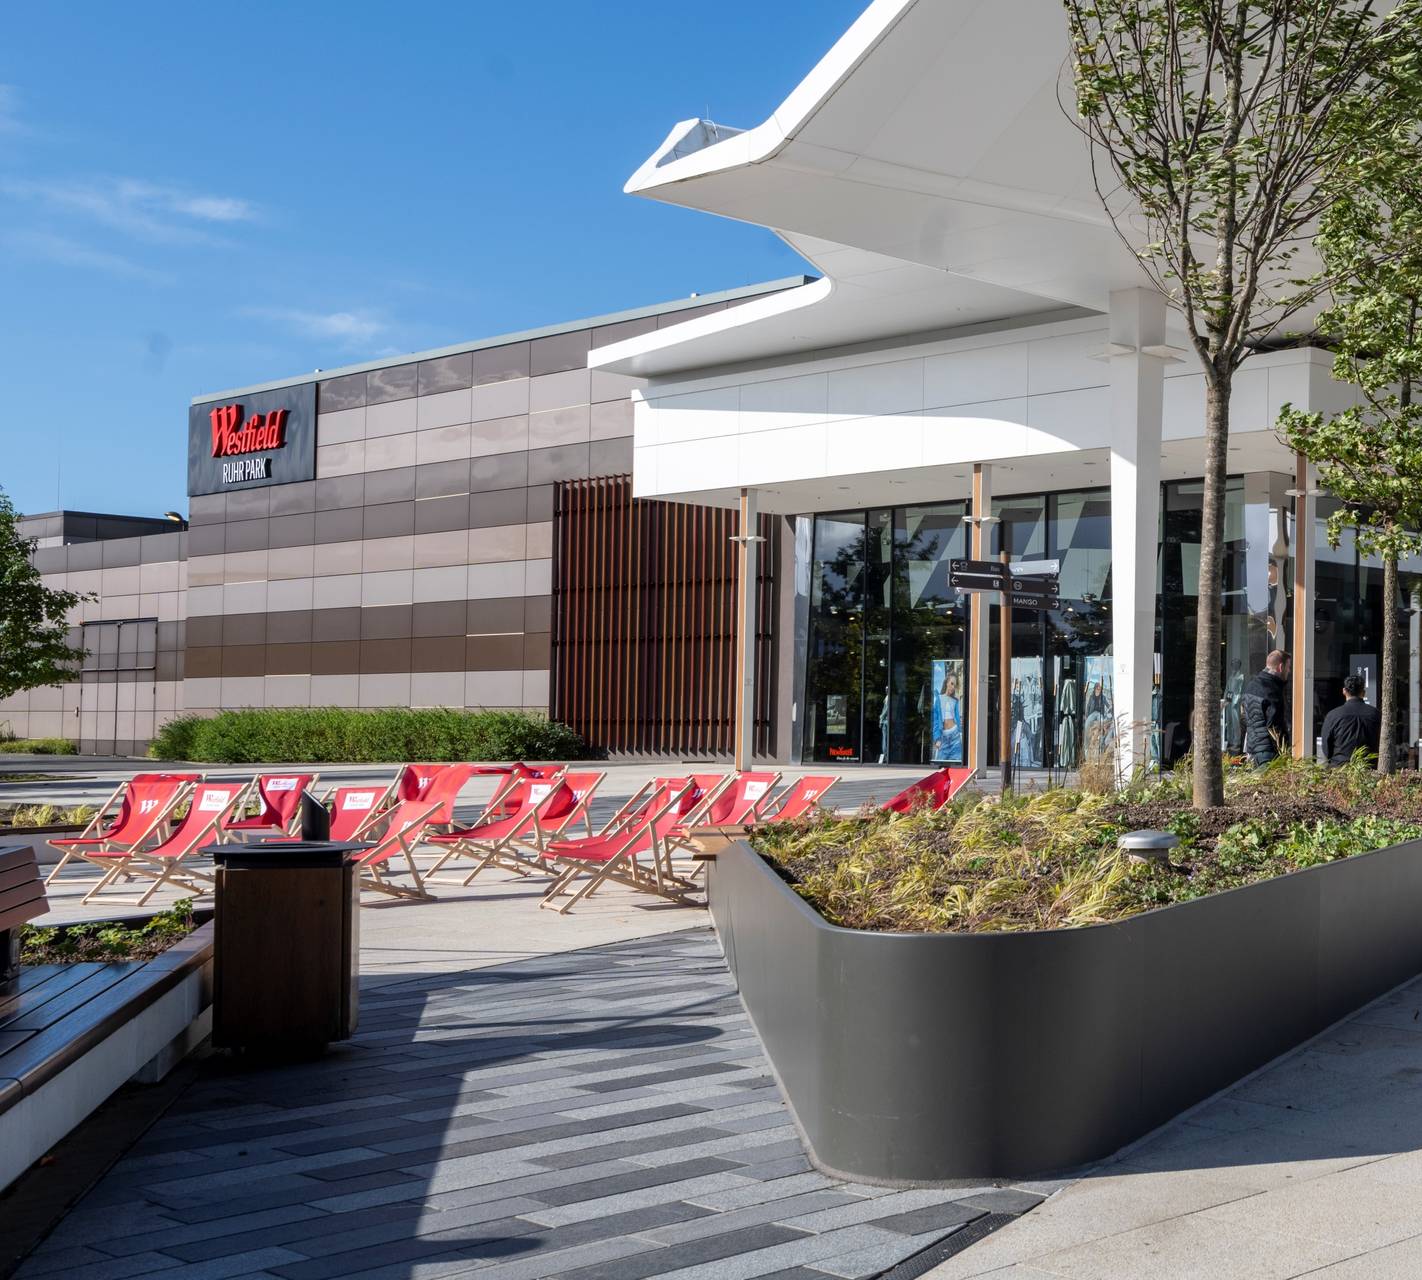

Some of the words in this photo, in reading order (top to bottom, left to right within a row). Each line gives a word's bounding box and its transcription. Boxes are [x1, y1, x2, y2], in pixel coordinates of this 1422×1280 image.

[209, 404, 284, 457] Westfield
[222, 461, 244, 484] RUHR
[245, 458, 267, 480] PARK
[1013, 597, 1038, 606] MANGO
